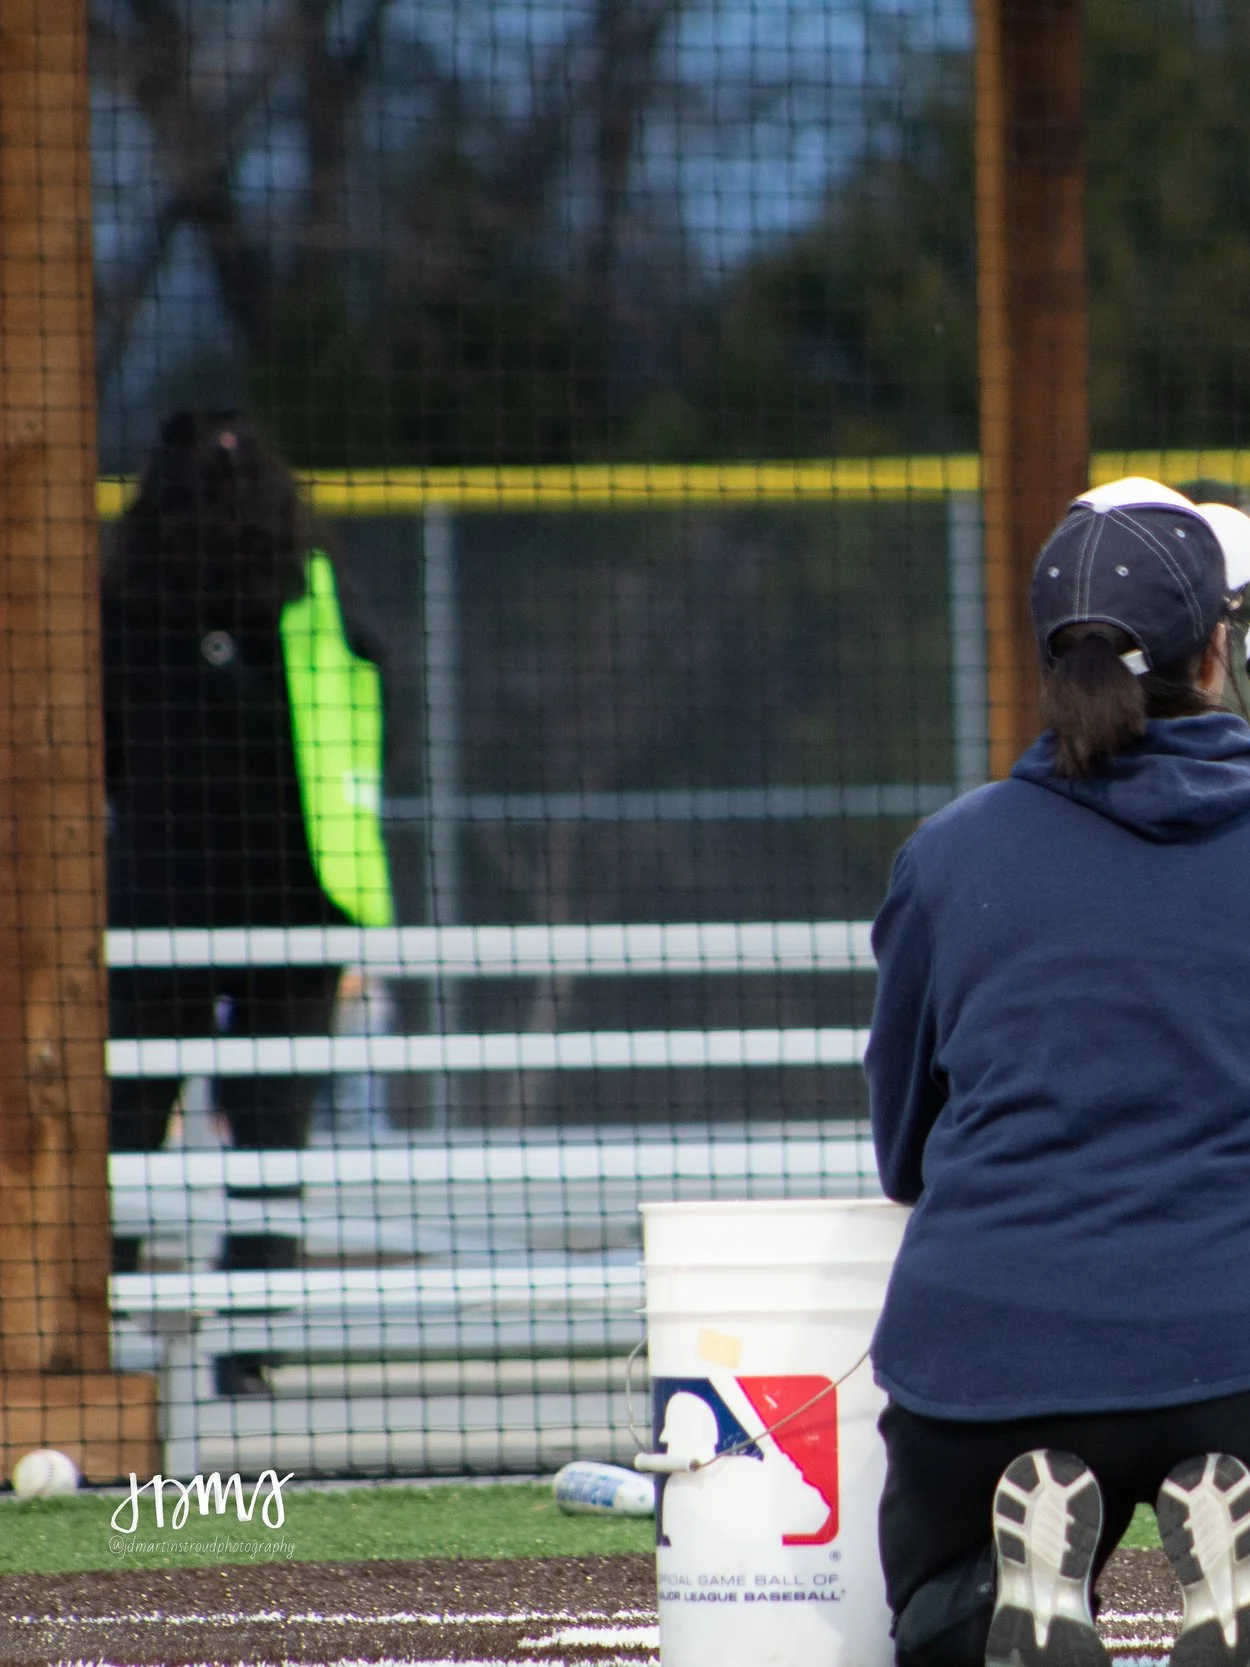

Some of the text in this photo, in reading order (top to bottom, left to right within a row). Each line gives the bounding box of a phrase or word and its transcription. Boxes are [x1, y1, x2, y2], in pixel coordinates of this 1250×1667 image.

[698, 1574, 746, 1586] GAME
[755, 1574, 805, 1586] BALL
[813, 1573, 839, 1586] OF
[657, 1590, 842, 1602] AJOR LEAGUE BASEBALL
